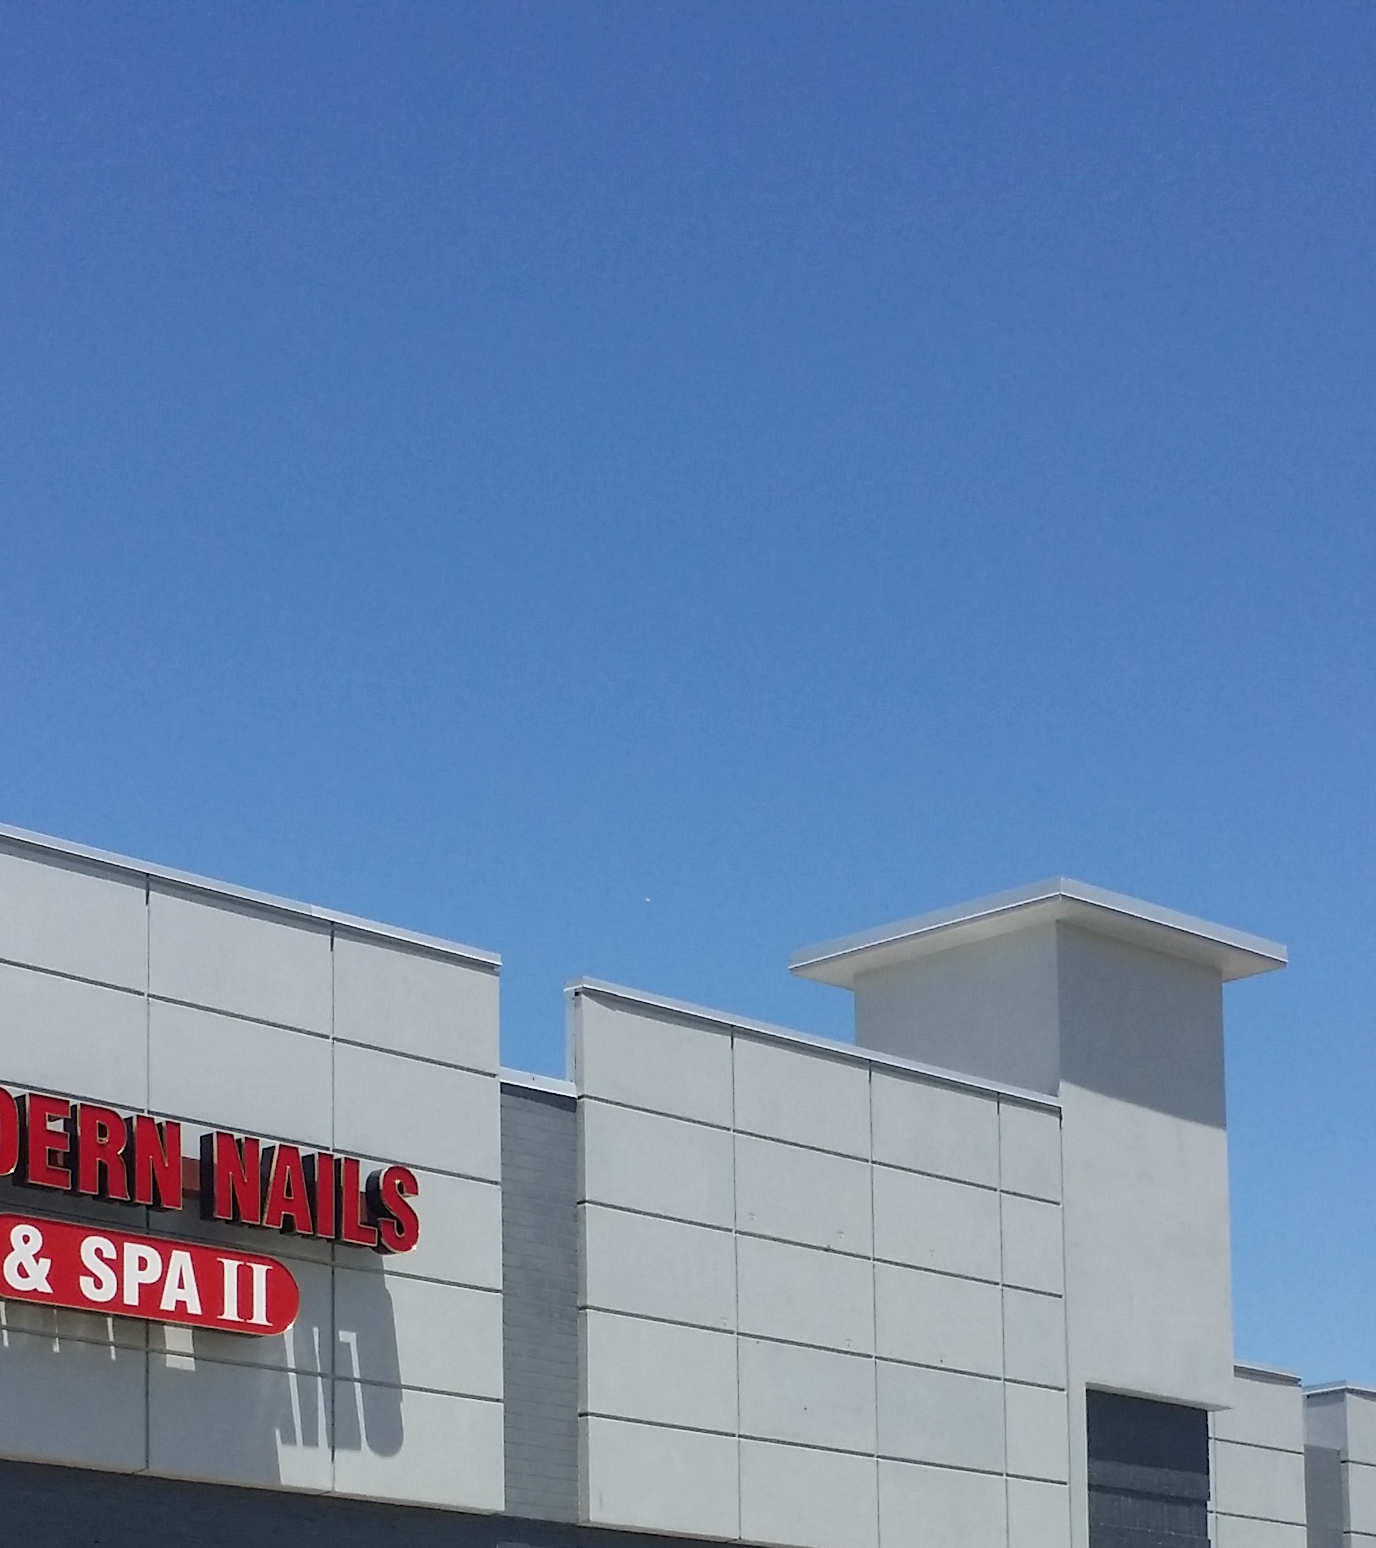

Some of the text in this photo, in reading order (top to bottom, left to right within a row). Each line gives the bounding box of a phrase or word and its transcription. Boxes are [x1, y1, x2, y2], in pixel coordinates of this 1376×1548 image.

[214, 1131, 420, 1255] NAILS
[2, 1223, 273, 1327] & SPA II
